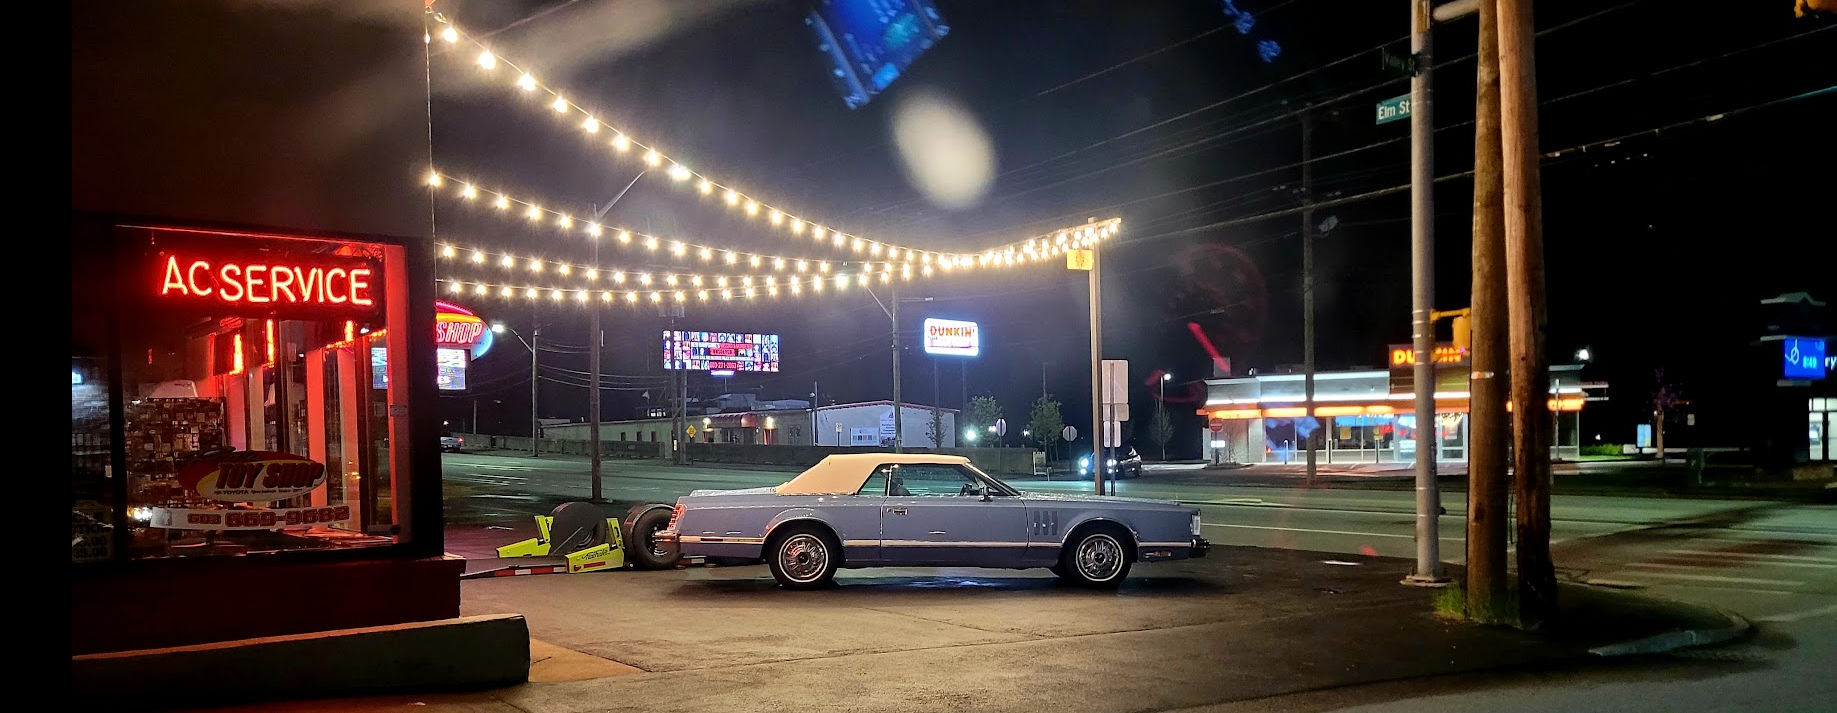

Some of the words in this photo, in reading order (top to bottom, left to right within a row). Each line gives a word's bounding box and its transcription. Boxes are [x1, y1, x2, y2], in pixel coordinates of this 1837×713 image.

[1378, 106, 1396, 119] Elm
[1400, 100, 1410, 114] St
[161, 254, 213, 297] AC
[219, 263, 373, 306] SERVICE
[435, 321, 483, 343] SHOP
[930, 325, 975, 338] DUNKIN'
[216, 463, 264, 488] TOY
[263, 463, 325, 488] SHOP
[225, 506, 350, 527] 669-9682
